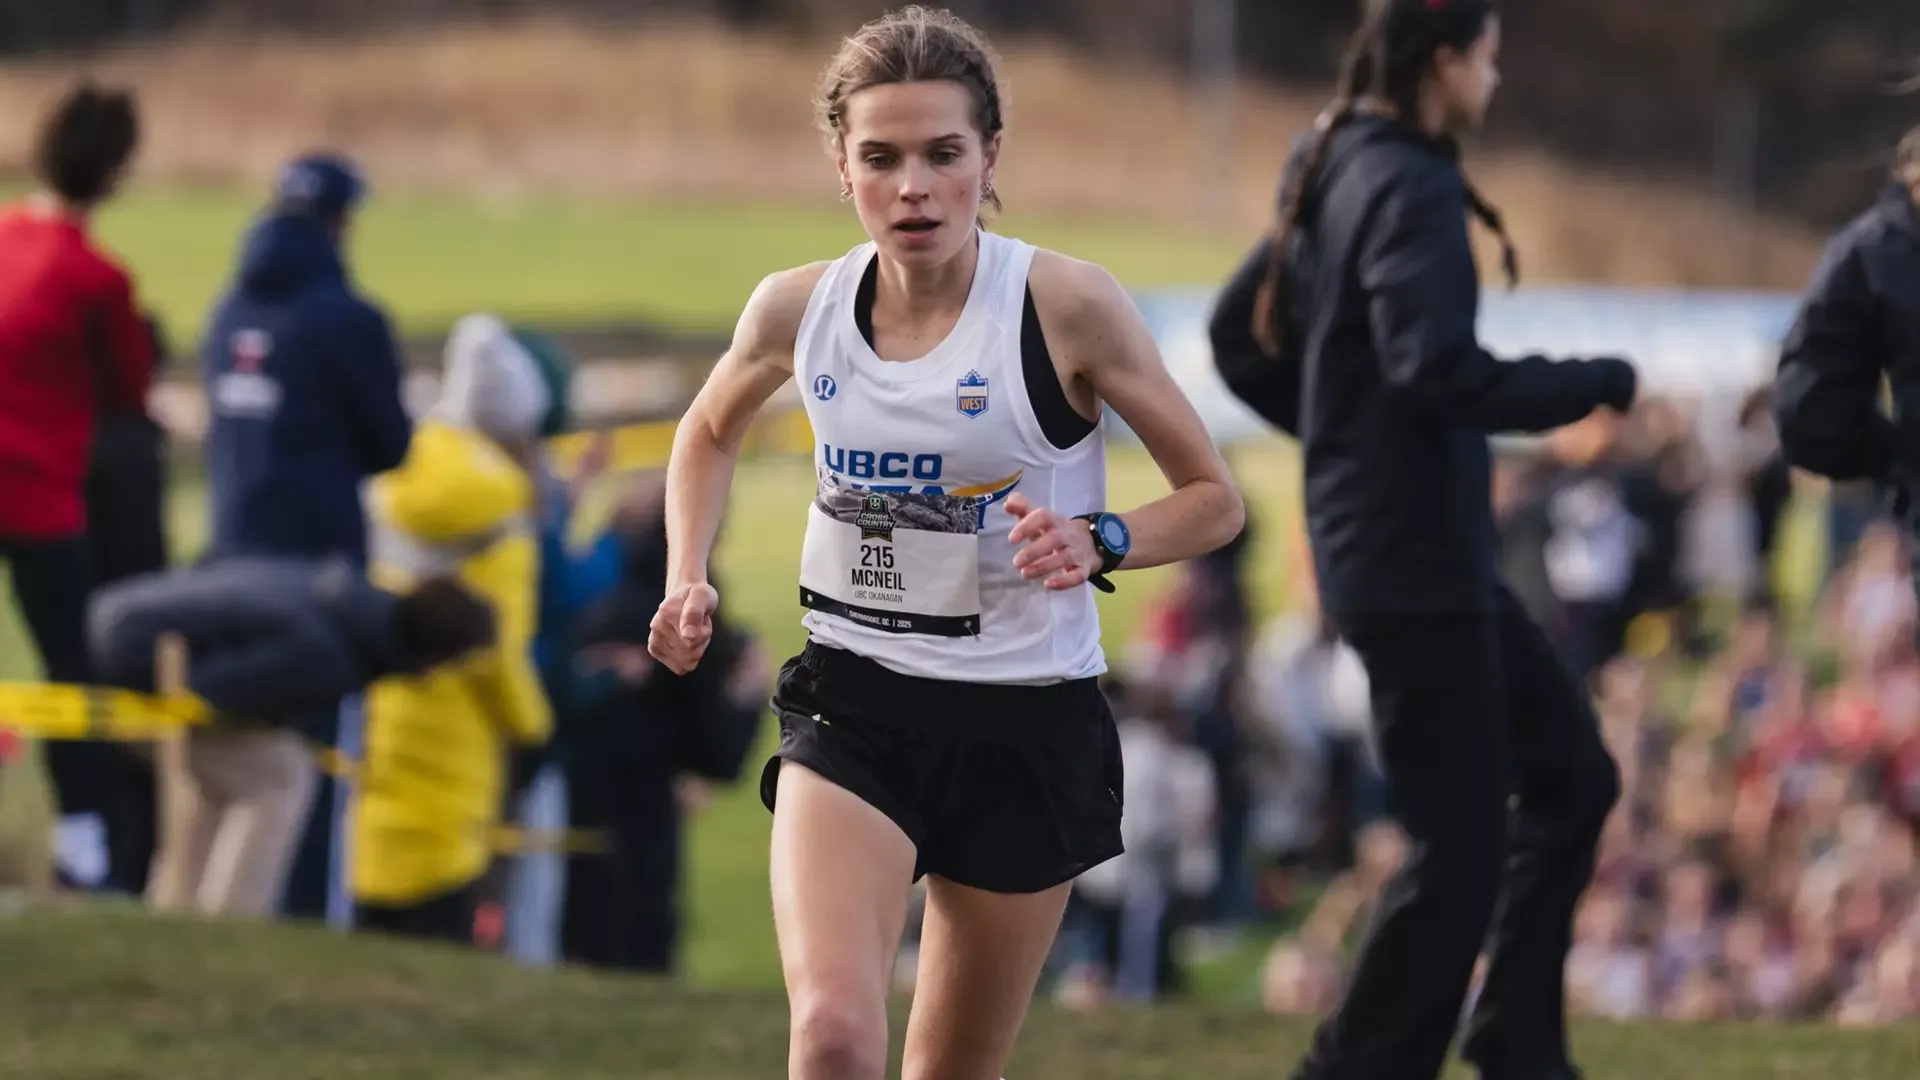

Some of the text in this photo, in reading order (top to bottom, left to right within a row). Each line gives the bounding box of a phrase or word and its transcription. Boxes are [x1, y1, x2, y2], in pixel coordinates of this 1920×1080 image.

[961, 397, 985, 410] WEST
[824, 443, 942, 480] UBCO
[857, 519, 894, 528] COUNTRY
[860, 544, 894, 569] 215
[851, 568, 906, 591] MCNEIL
[854, 590, 903, 603] UBC OKANAGAN
[896, 619, 912, 629] 2025
